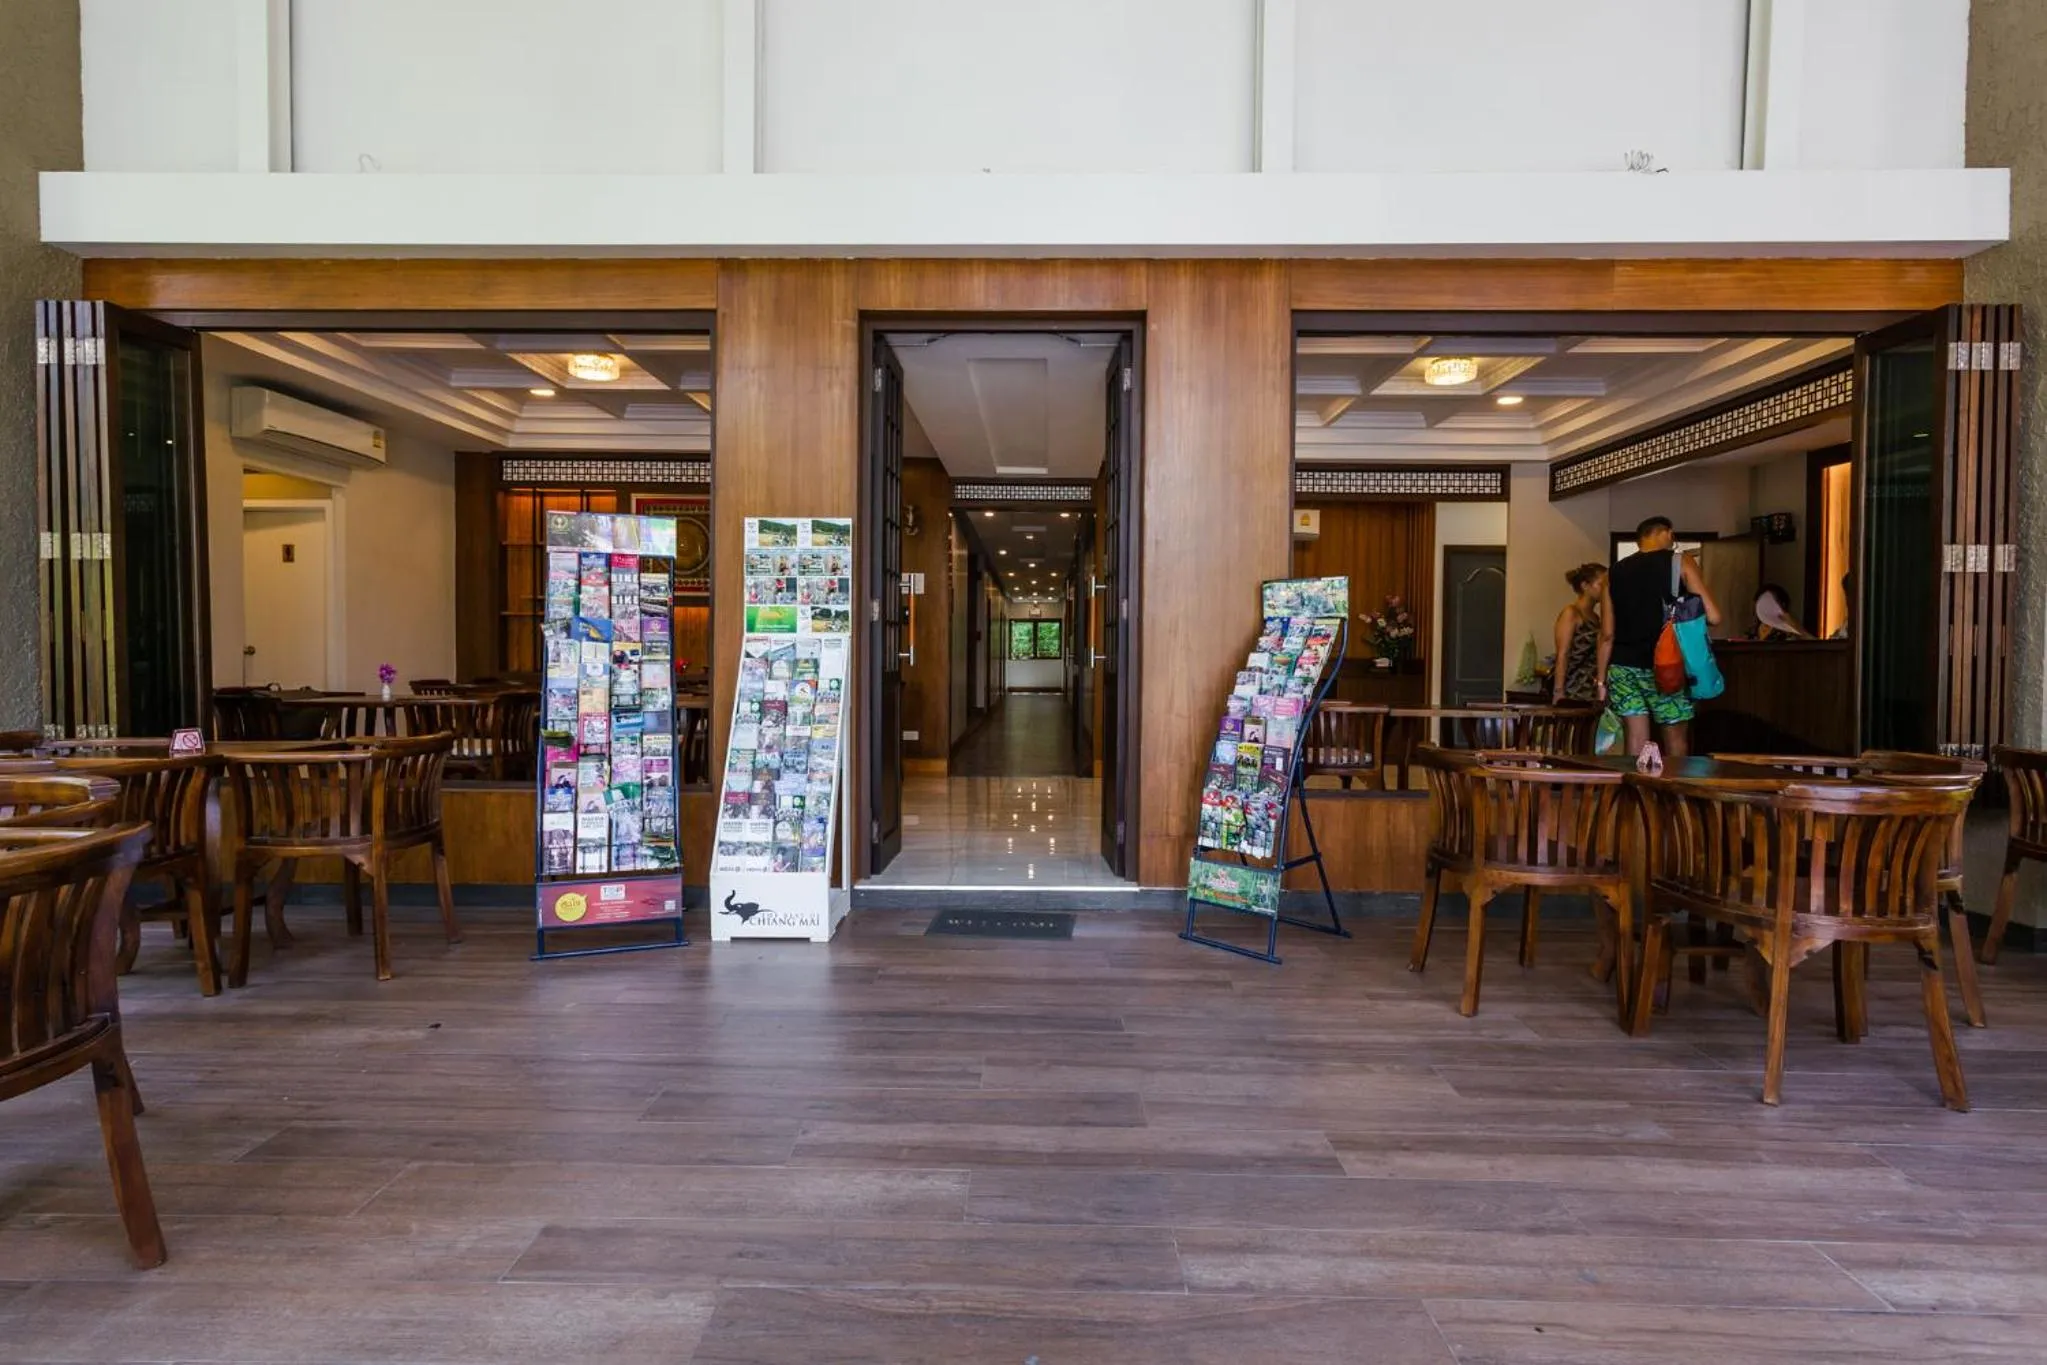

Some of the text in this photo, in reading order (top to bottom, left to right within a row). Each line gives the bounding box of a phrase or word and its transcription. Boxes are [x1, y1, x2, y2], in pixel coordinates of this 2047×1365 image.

[611, 574, 638, 583] BIKE
[611, 595, 639, 604] BIKE
[749, 916, 820, 926] CHIANG MAI
